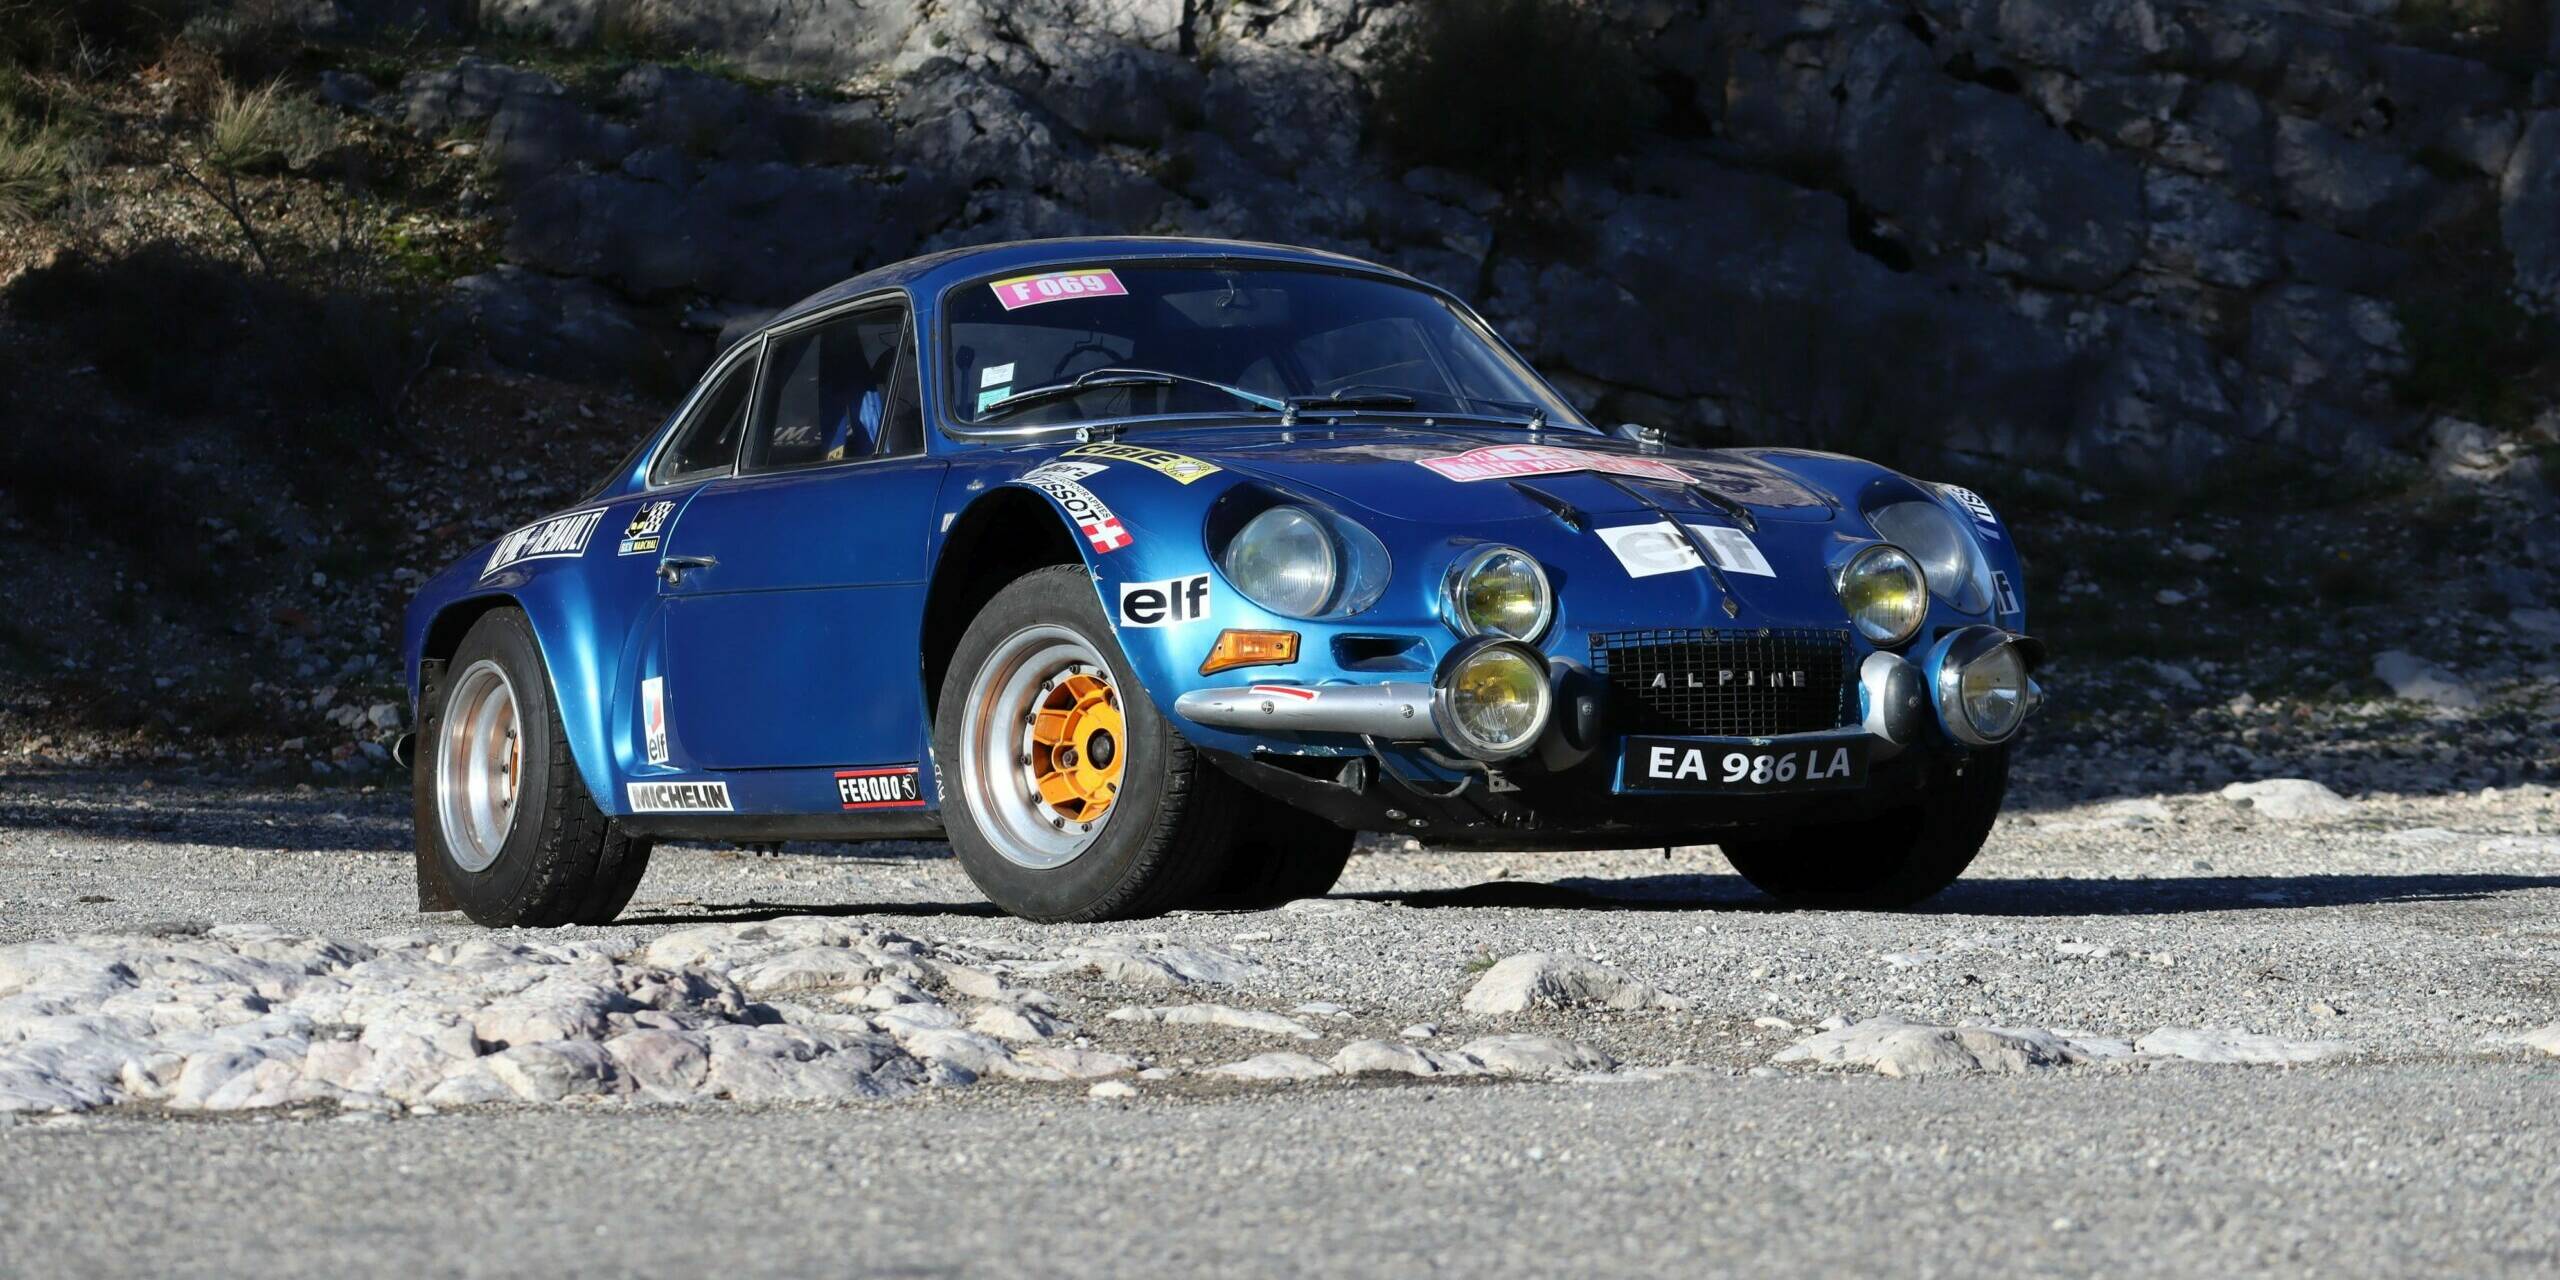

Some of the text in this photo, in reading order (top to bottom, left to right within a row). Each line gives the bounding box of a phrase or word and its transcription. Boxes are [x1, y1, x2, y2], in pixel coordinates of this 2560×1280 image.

[1010, 275, 1107, 301] F 069
[1123, 576, 1208, 624] elf
[1652, 670, 1805, 689] ALPINE
[649, 733, 666, 760] elf
[1648, 746, 1851, 784] EA 986 LA
[632, 785, 728, 809] MICHELIN
[838, 776, 902, 803] FERODO
